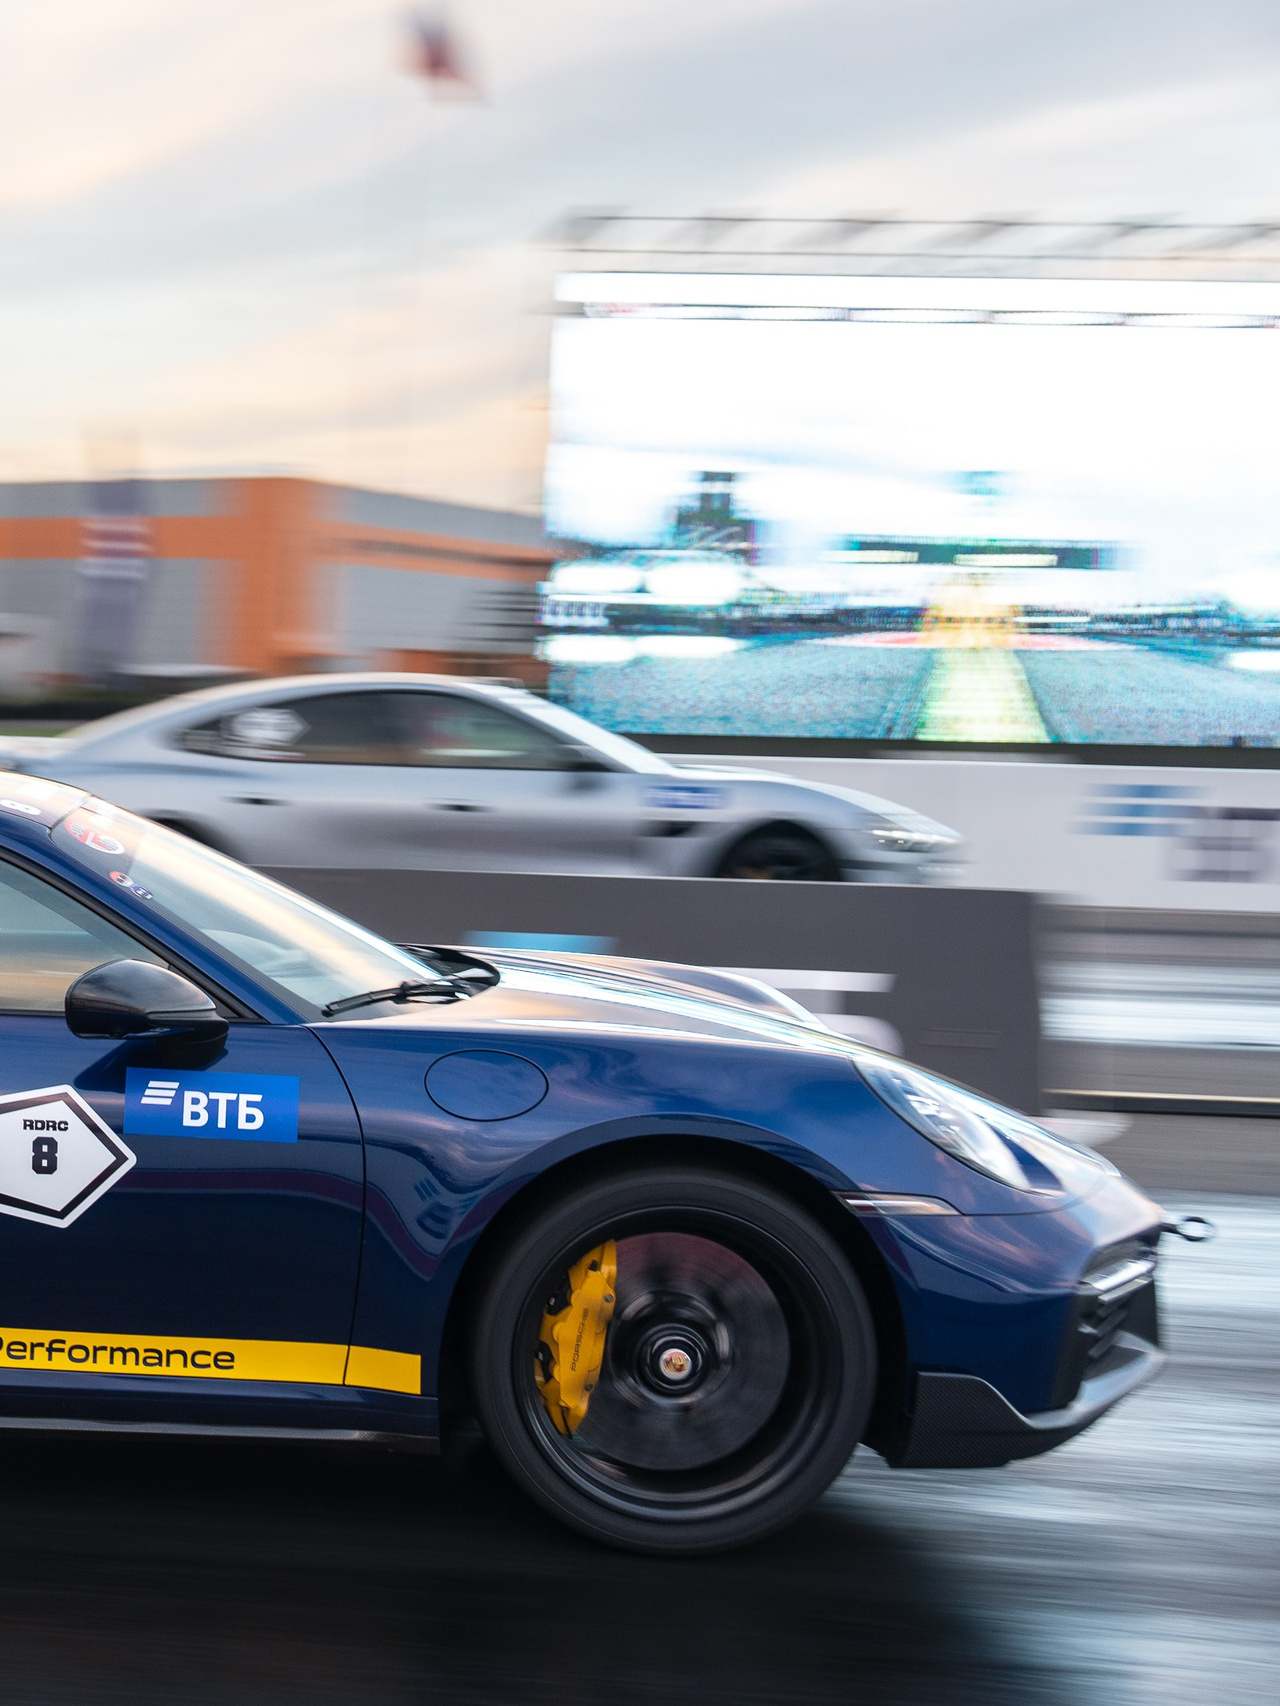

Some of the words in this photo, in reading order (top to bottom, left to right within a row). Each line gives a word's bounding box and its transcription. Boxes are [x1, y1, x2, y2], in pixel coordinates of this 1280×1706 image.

[23, 1119, 69, 1132] RDRC
[182, 1091, 265, 1130] ВТБ
[31, 1136, 59, 1176] 8
